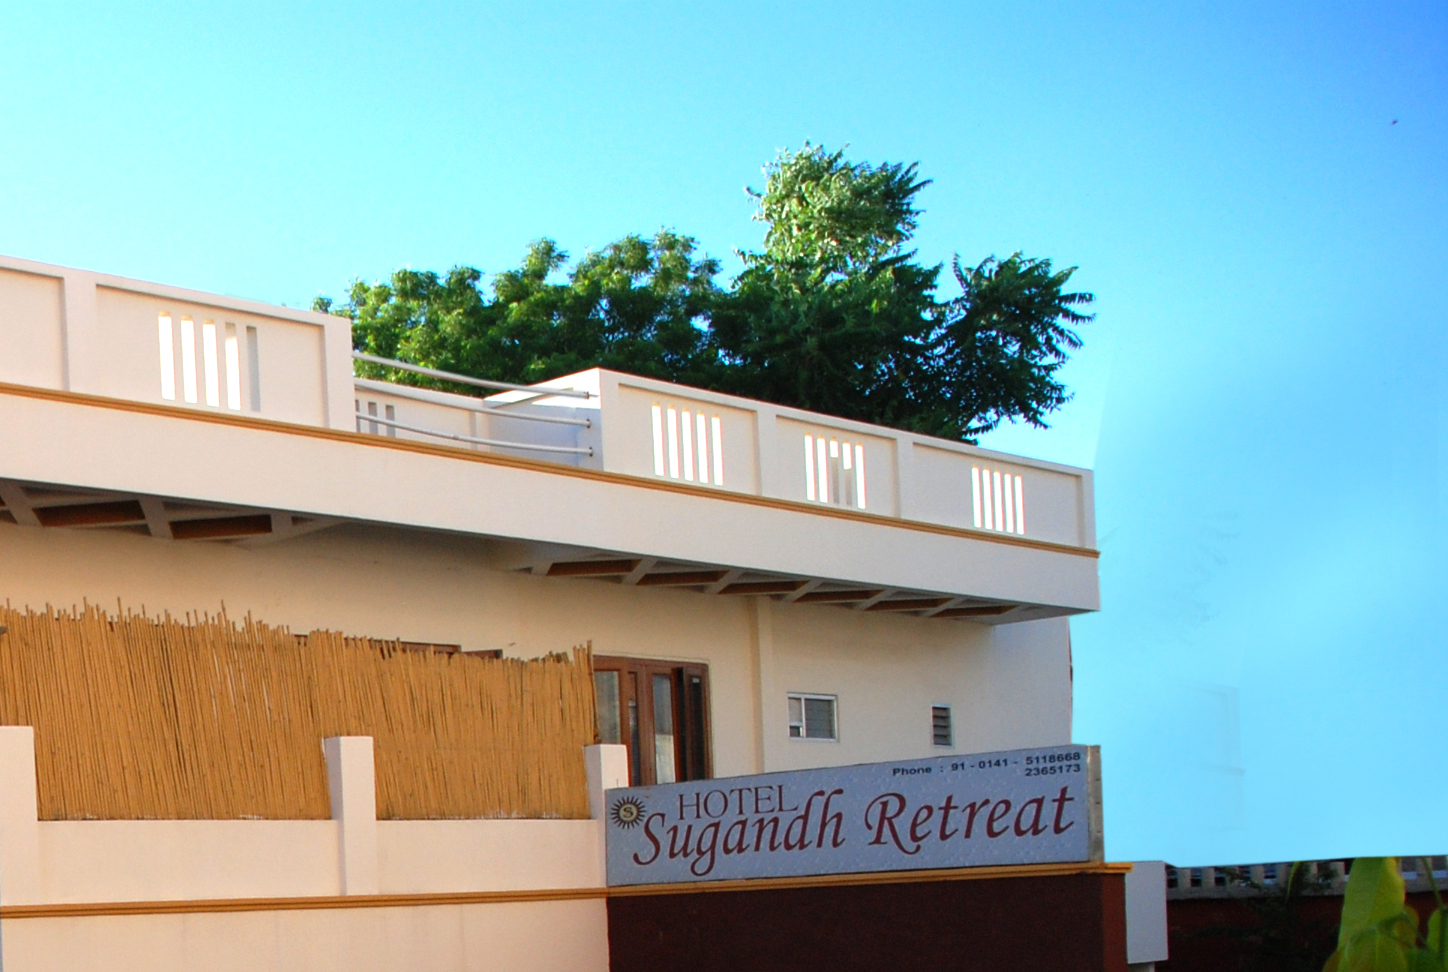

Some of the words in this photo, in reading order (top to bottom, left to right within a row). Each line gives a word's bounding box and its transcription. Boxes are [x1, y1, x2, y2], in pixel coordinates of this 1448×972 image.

[892, 765, 932, 776] Phone
[951, 762, 965, 771] 91
[978, 758, 1008, 769] 0141
[1025, 752, 1081, 765] 5118668
[1025, 764, 1081, 777] 2365173
[678, 785, 799, 820] HOTEL
[632, 788, 846, 877] Sugandh
[863, 785, 1076, 856] Retreat
